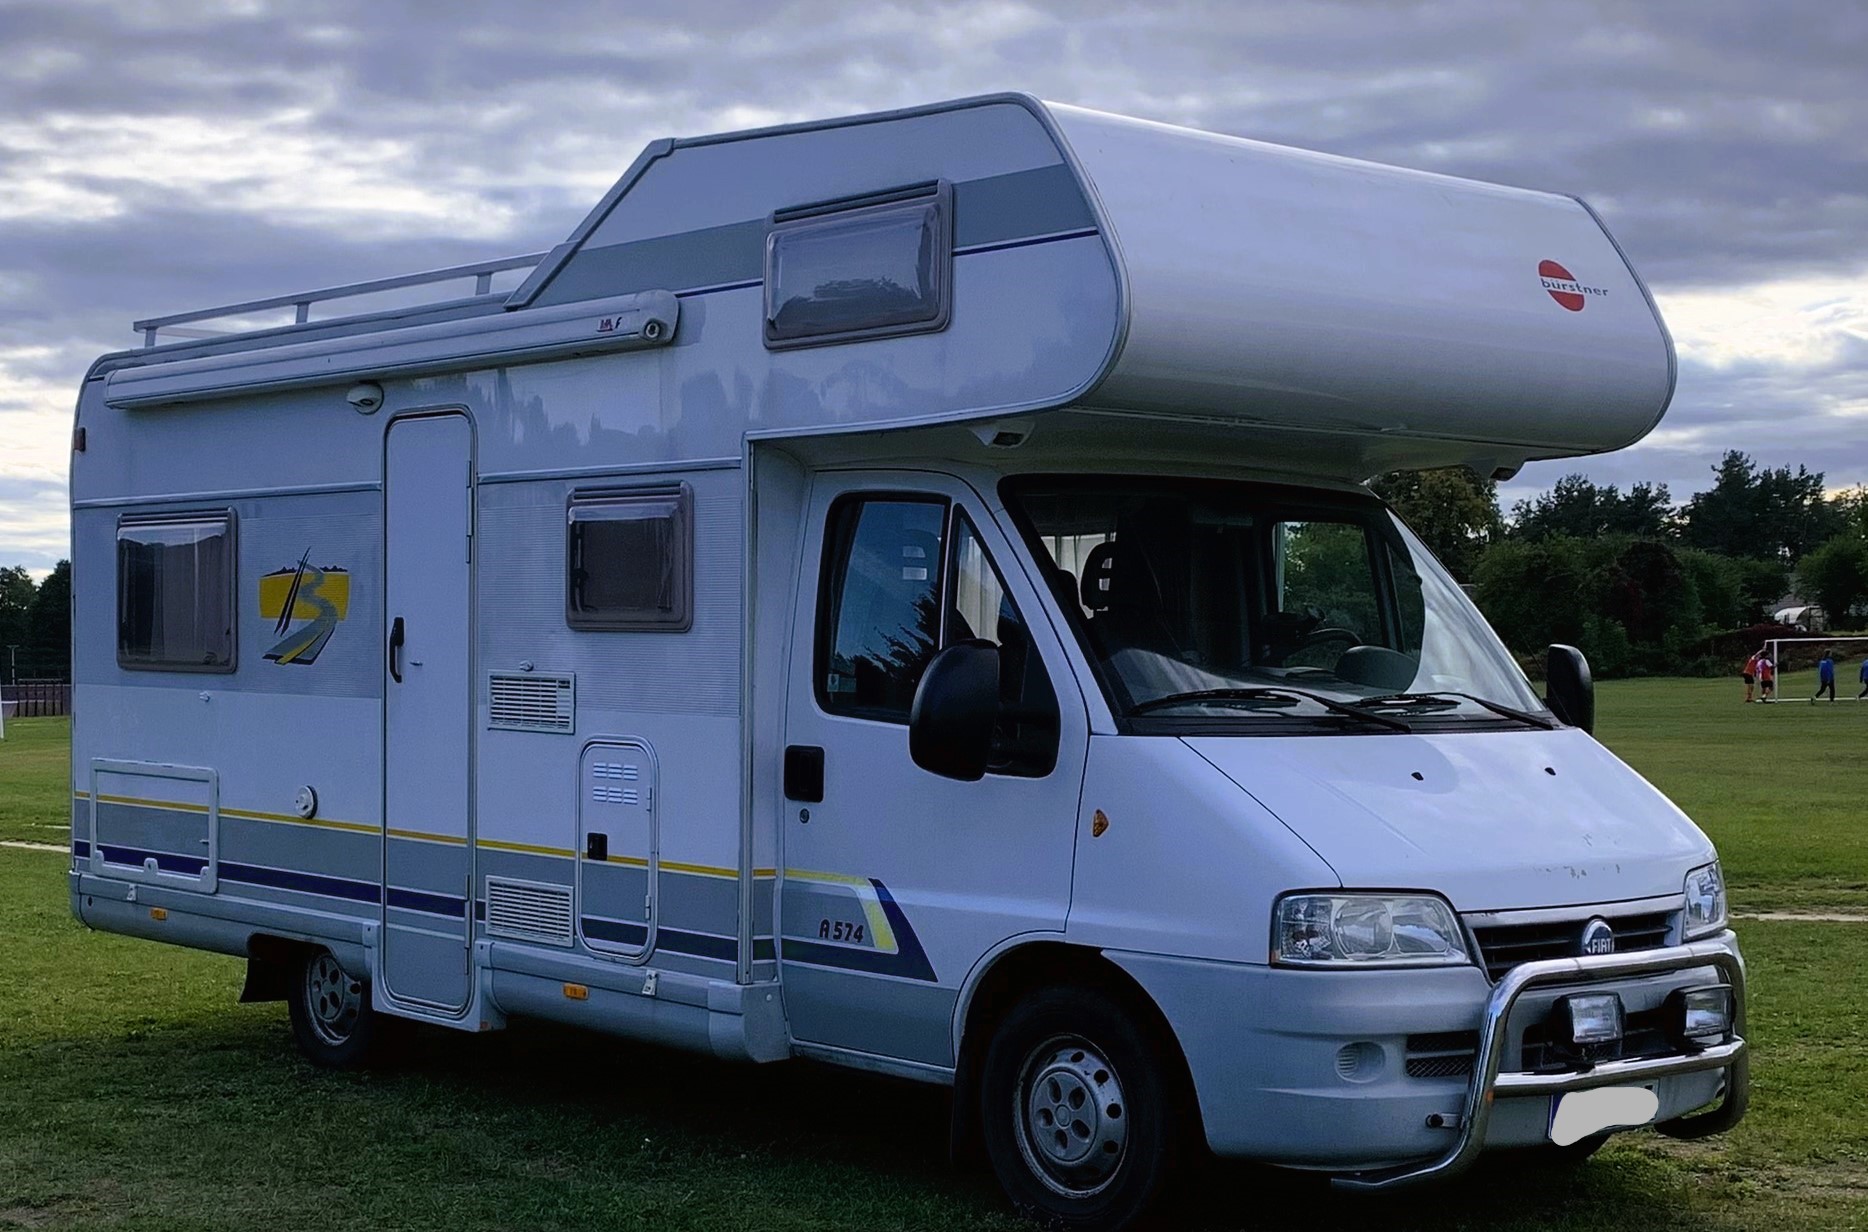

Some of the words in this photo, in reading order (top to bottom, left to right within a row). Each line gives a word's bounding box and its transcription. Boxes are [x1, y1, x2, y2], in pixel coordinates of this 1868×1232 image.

[819, 919, 830, 939] A
[833, 921, 864, 943] 574
[1591, 938, 1612, 954] FIAT
